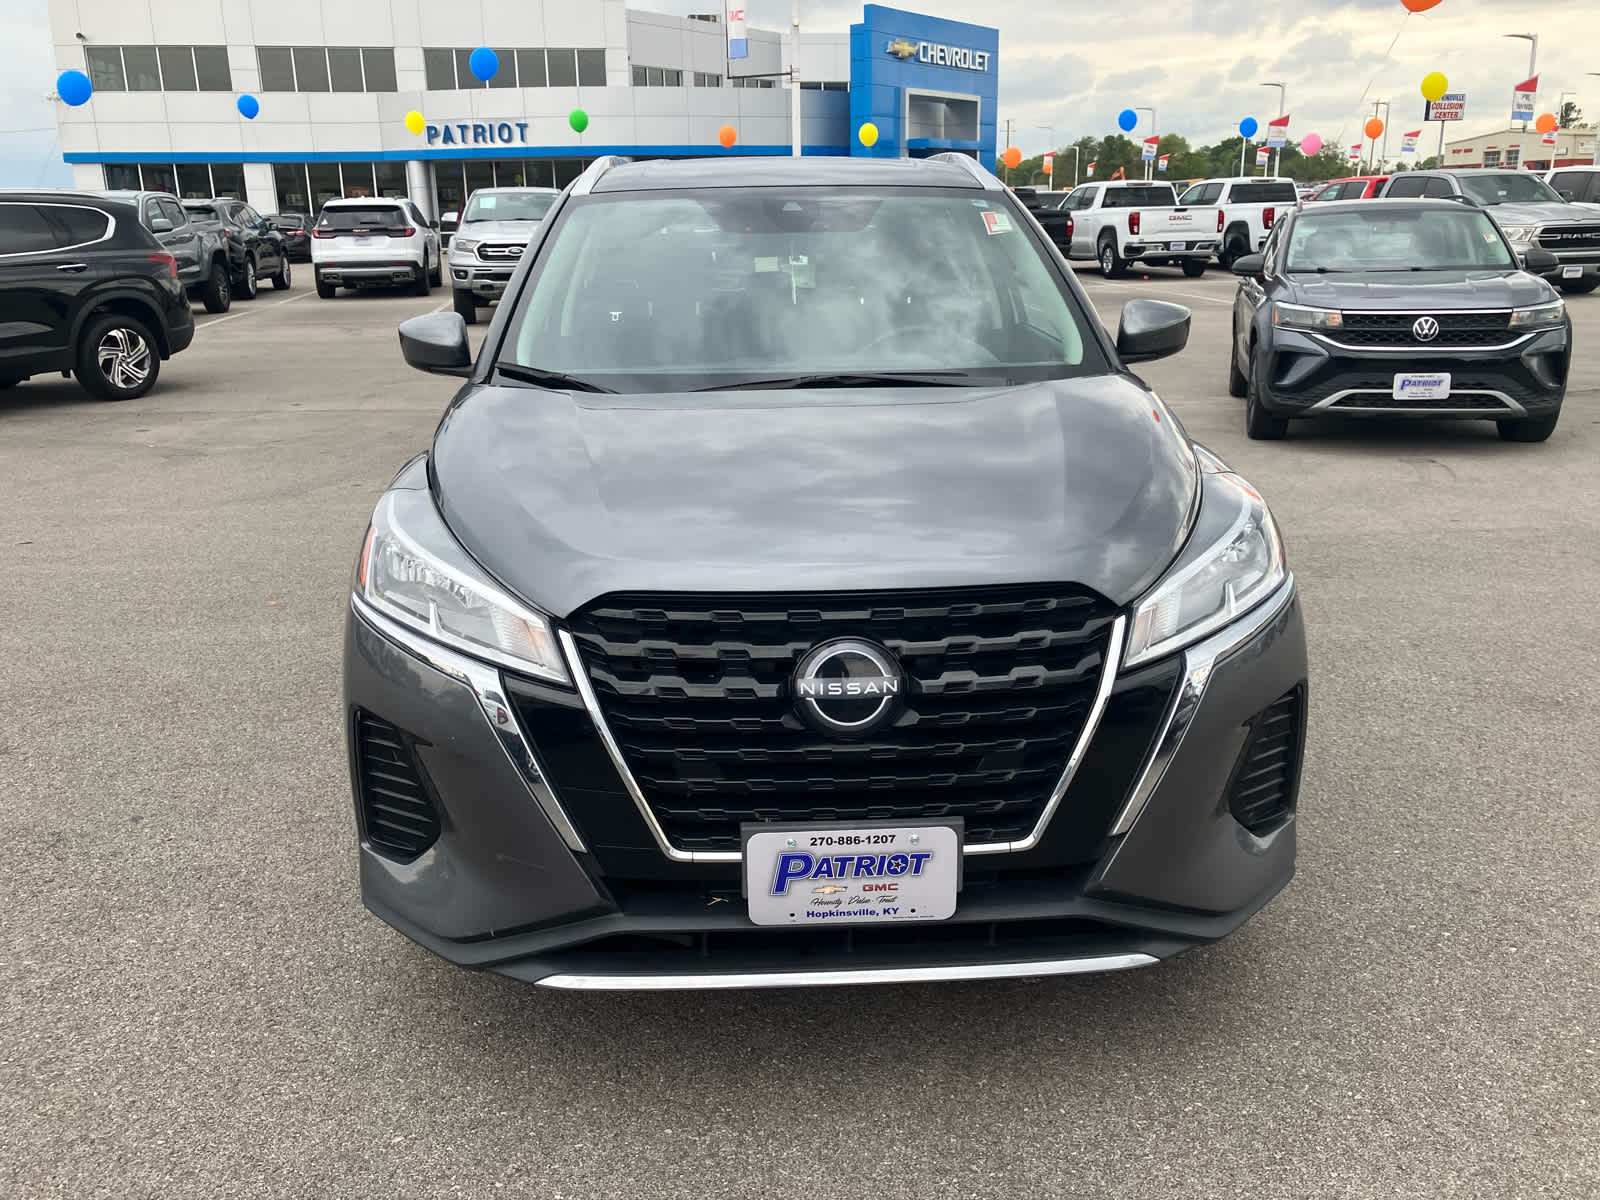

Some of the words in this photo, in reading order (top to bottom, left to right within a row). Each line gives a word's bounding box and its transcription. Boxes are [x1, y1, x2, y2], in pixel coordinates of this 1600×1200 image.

[919, 41, 990, 72] CHEVROLET
[1431, 102, 1464, 110] COLLISION
[1434, 111, 1459, 119] CENTER
[426, 122, 529, 145] PATRIOT
[1400, 379, 1443, 391] PATRIOT
[800, 680, 898, 695] NISSAN
[810, 834, 897, 847] 270-886-1207
[771, 851, 932, 896] PATRIOT
[862, 883, 899, 892] GMC
[806, 907, 880, 919] Hopkinsville,
[883, 907, 900, 915] KY
